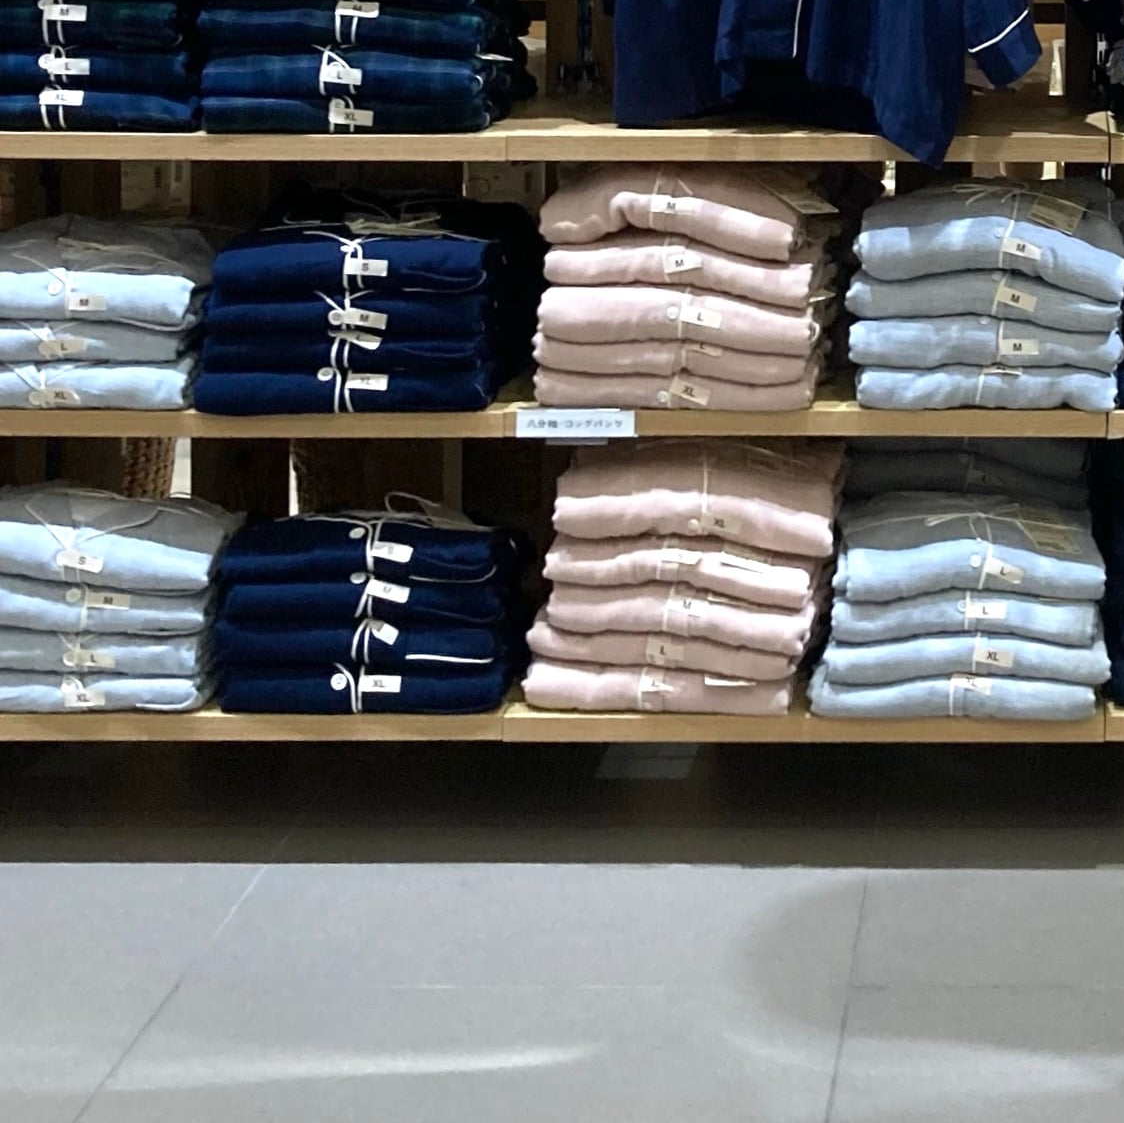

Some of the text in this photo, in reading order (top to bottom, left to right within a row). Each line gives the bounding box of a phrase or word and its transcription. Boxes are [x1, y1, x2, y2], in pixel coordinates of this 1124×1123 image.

[60, 8, 69, 16] M
[65, 62, 71, 71] L
[337, 72, 343, 80] L
[344, 112, 356, 121] XL
[667, 202, 676, 210] M
[1016, 243, 1026, 253] M
[362, 263, 369, 272] S
[675, 259, 683, 267] M
[1010, 294, 1020, 303] M
[359, 314, 369, 322] M
[697, 313, 703, 321] L
[60, 342, 68, 351] L
[1013, 343, 1022, 351] M
[54, 391, 66, 400] XL
[682, 386, 695, 397] XL
[714, 518, 725, 528] XL
[78, 556, 86, 565] S
[1000, 567, 1006, 576] L
[103, 596, 113, 605] M
[683, 600, 692, 609] M
[982, 606, 988, 615] L
[660, 646, 665, 655] L
[90, 654, 97, 663] L
[987, 652, 998, 661] XL
[373, 680, 385, 688] XL
[76, 694, 90, 702] XL
